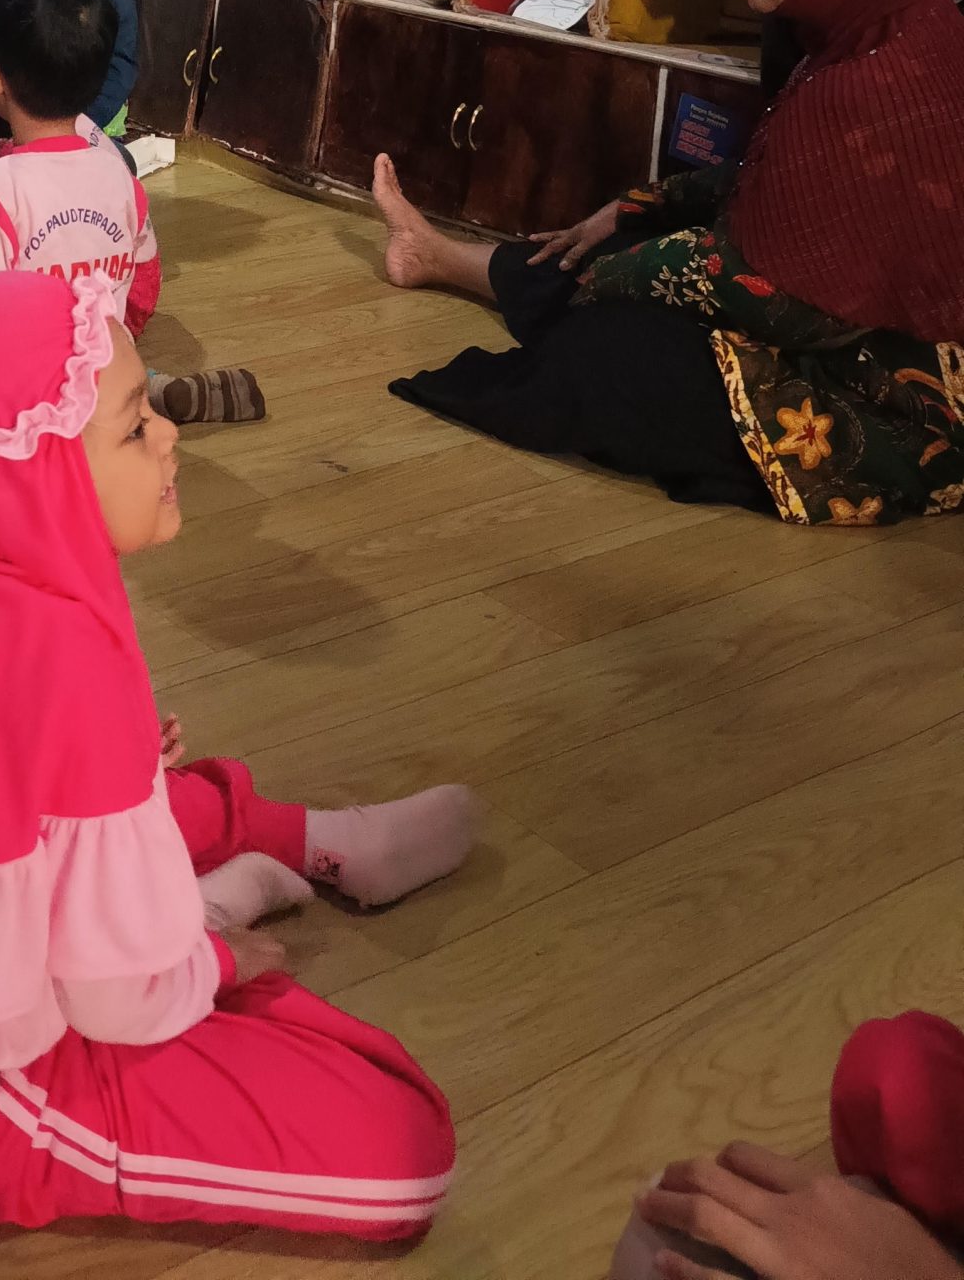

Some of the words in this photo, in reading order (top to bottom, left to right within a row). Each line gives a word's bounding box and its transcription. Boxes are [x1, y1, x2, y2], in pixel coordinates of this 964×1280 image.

[24, 228, 46, 260] POS
[46, 209, 78, 233] PAUD
[77, 208, 124, 243] TERPADU
